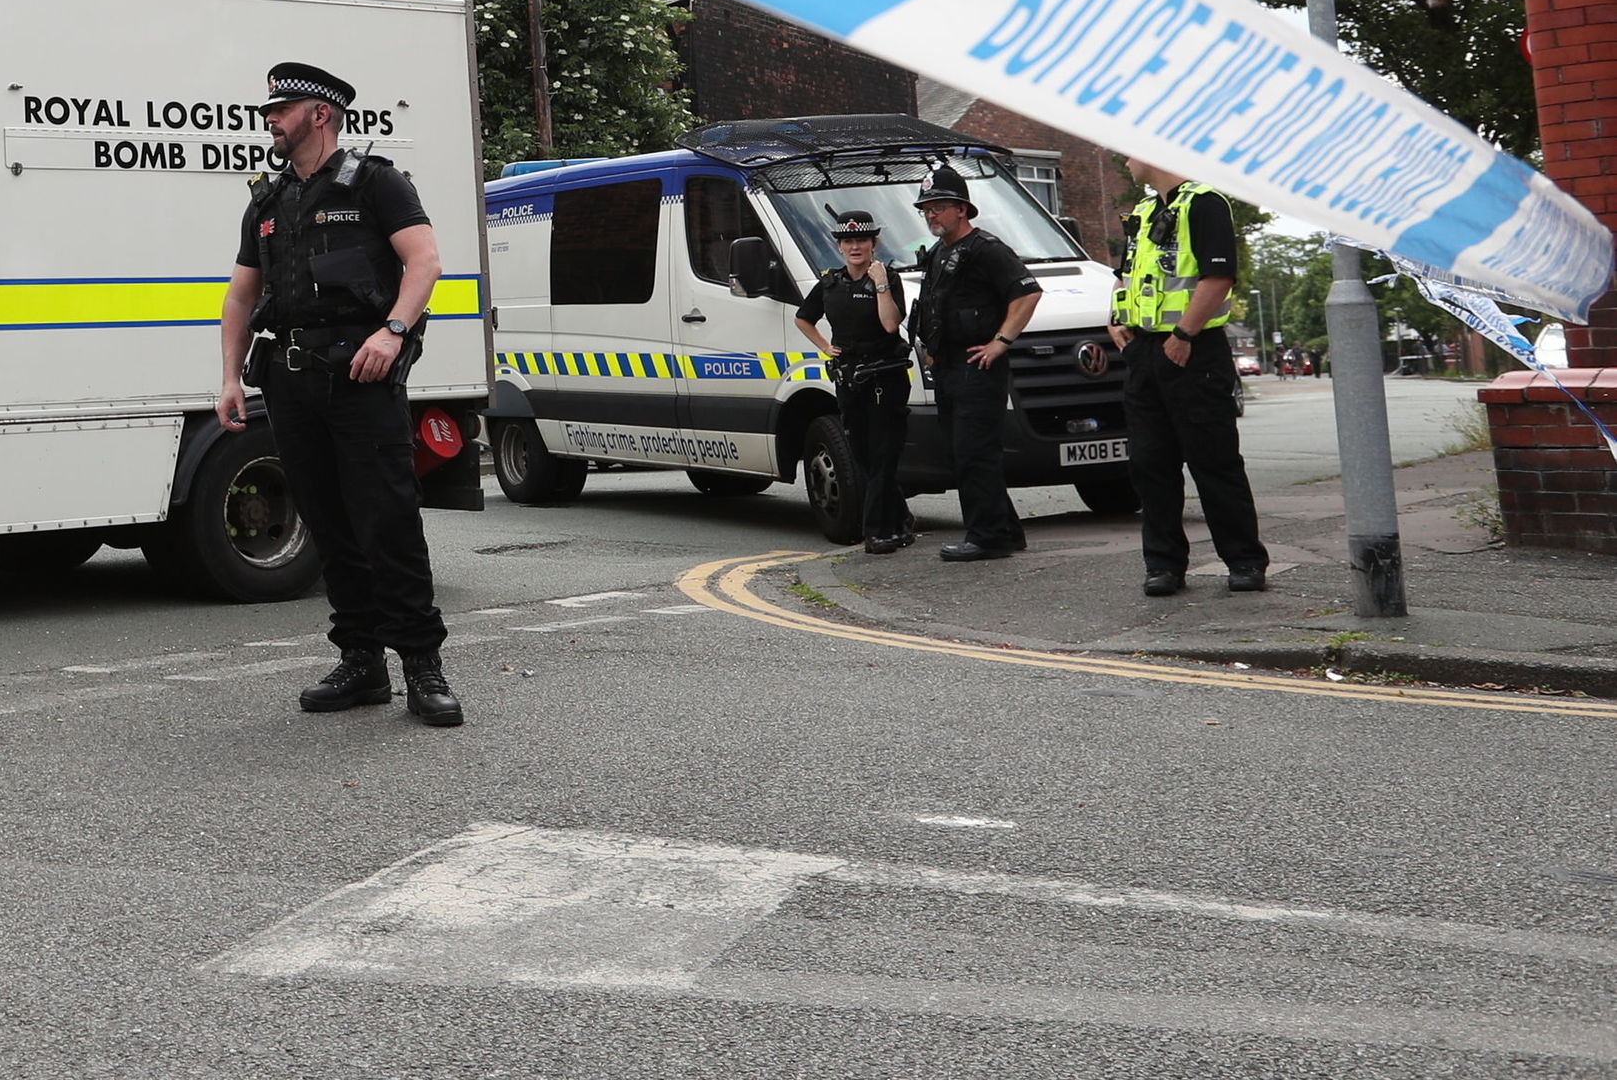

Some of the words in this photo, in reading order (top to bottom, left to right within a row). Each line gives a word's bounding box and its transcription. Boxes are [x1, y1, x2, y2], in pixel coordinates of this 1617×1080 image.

[24, 96, 130, 127] ROYAL
[340, 108, 393, 136] RPS
[95, 140, 186, 170] BOMB
[203, 143, 288, 173] DISPO
[327, 214, 360, 222] POLICE
[502, 204, 534, 219] POLICE
[704, 362, 751, 376] POLICE
[565, 423, 607, 454] Fighting
[606, 428, 641, 452] crime,
[640, 431, 697, 462] protecting
[697, 435, 739, 465] people
[1067, 443, 1108, 462] MX08
[1112, 441, 1129, 458] ET
